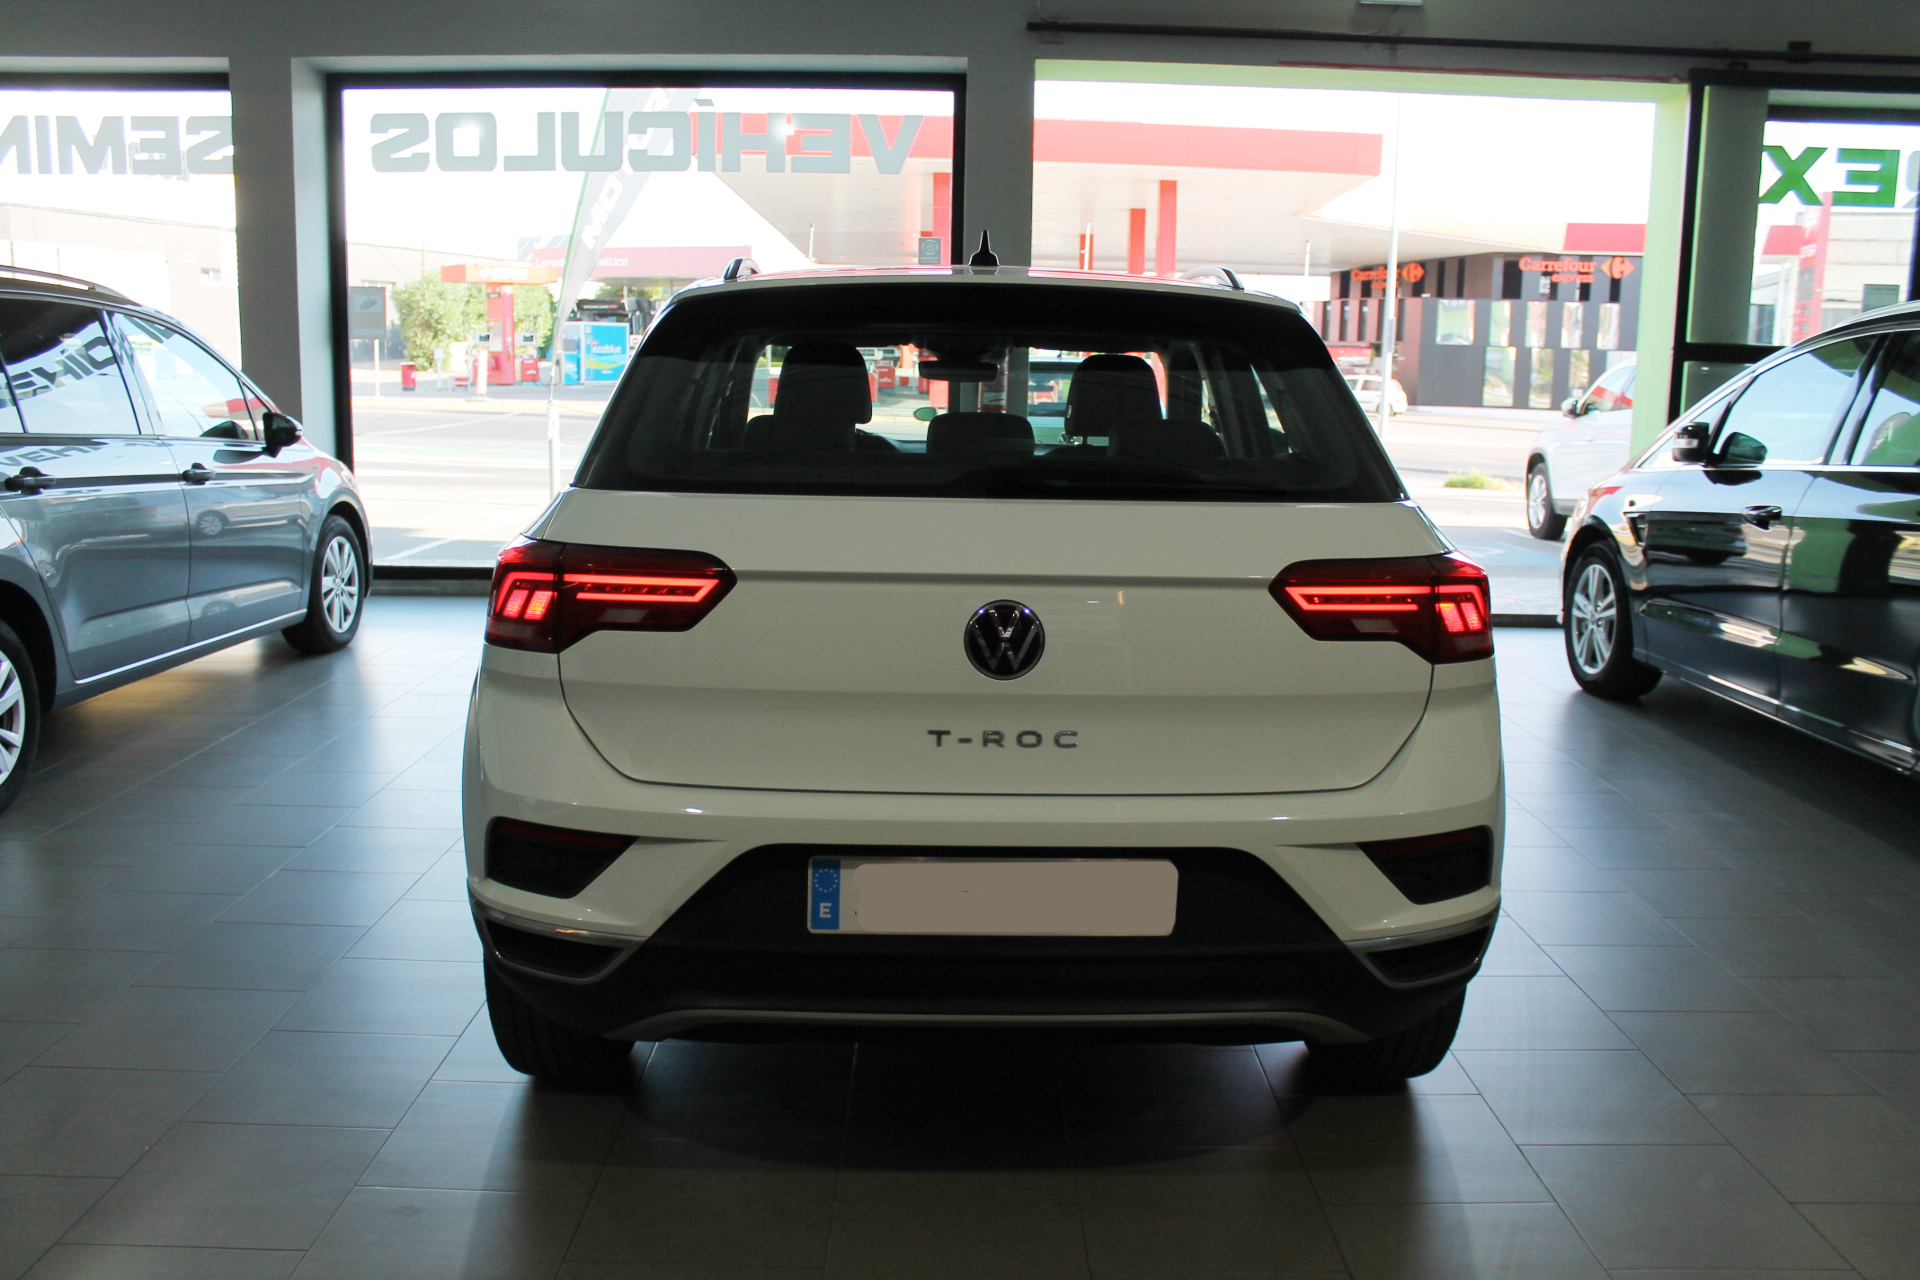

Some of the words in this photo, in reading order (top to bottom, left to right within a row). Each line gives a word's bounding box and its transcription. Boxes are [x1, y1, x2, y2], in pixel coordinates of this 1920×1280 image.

[1518, 256, 1598, 273] Carrefour
[927, 730, 1078, 749] T-ROC
[819, 902, 832, 919] E
